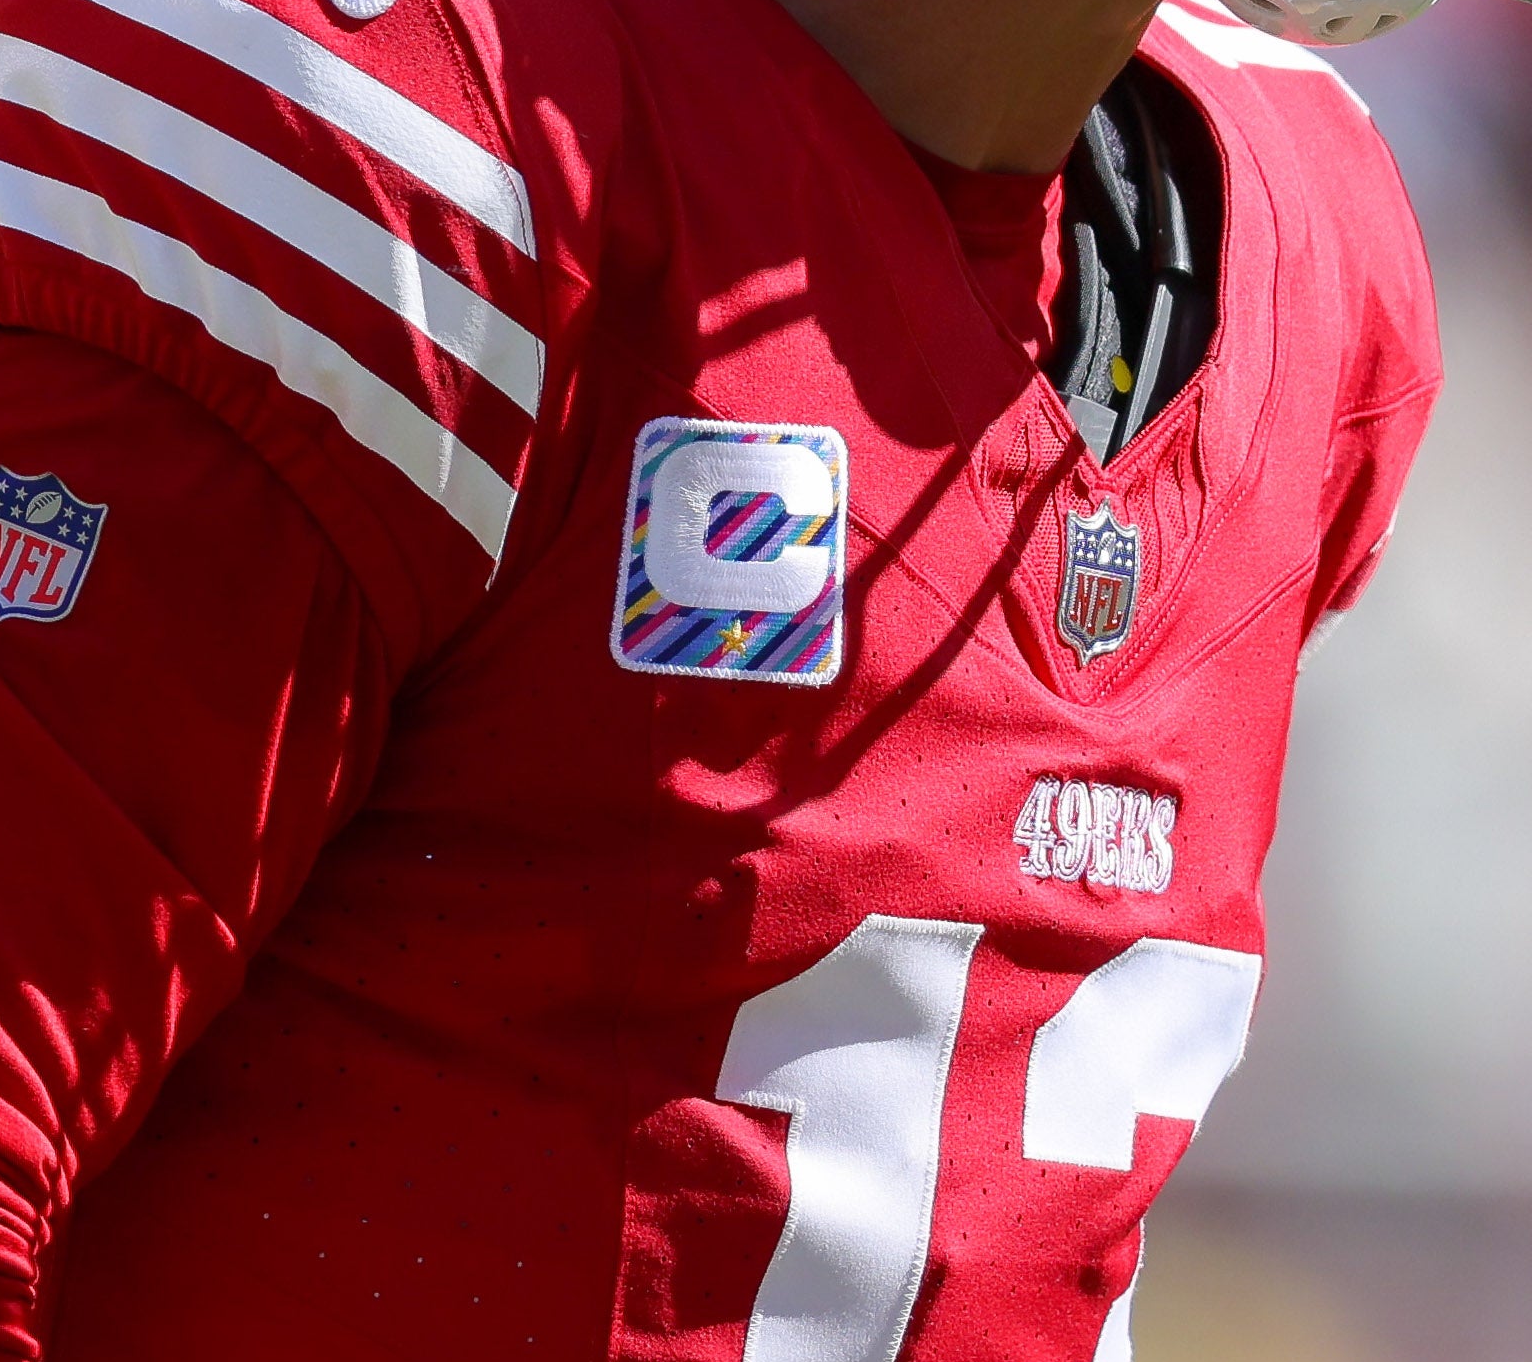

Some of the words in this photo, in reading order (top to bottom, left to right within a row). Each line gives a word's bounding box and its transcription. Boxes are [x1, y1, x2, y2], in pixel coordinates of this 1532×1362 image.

[644, 440, 835, 614] C
[1069, 571, 1124, 637] NFL
[1012, 775, 1177, 896] 49ERS
